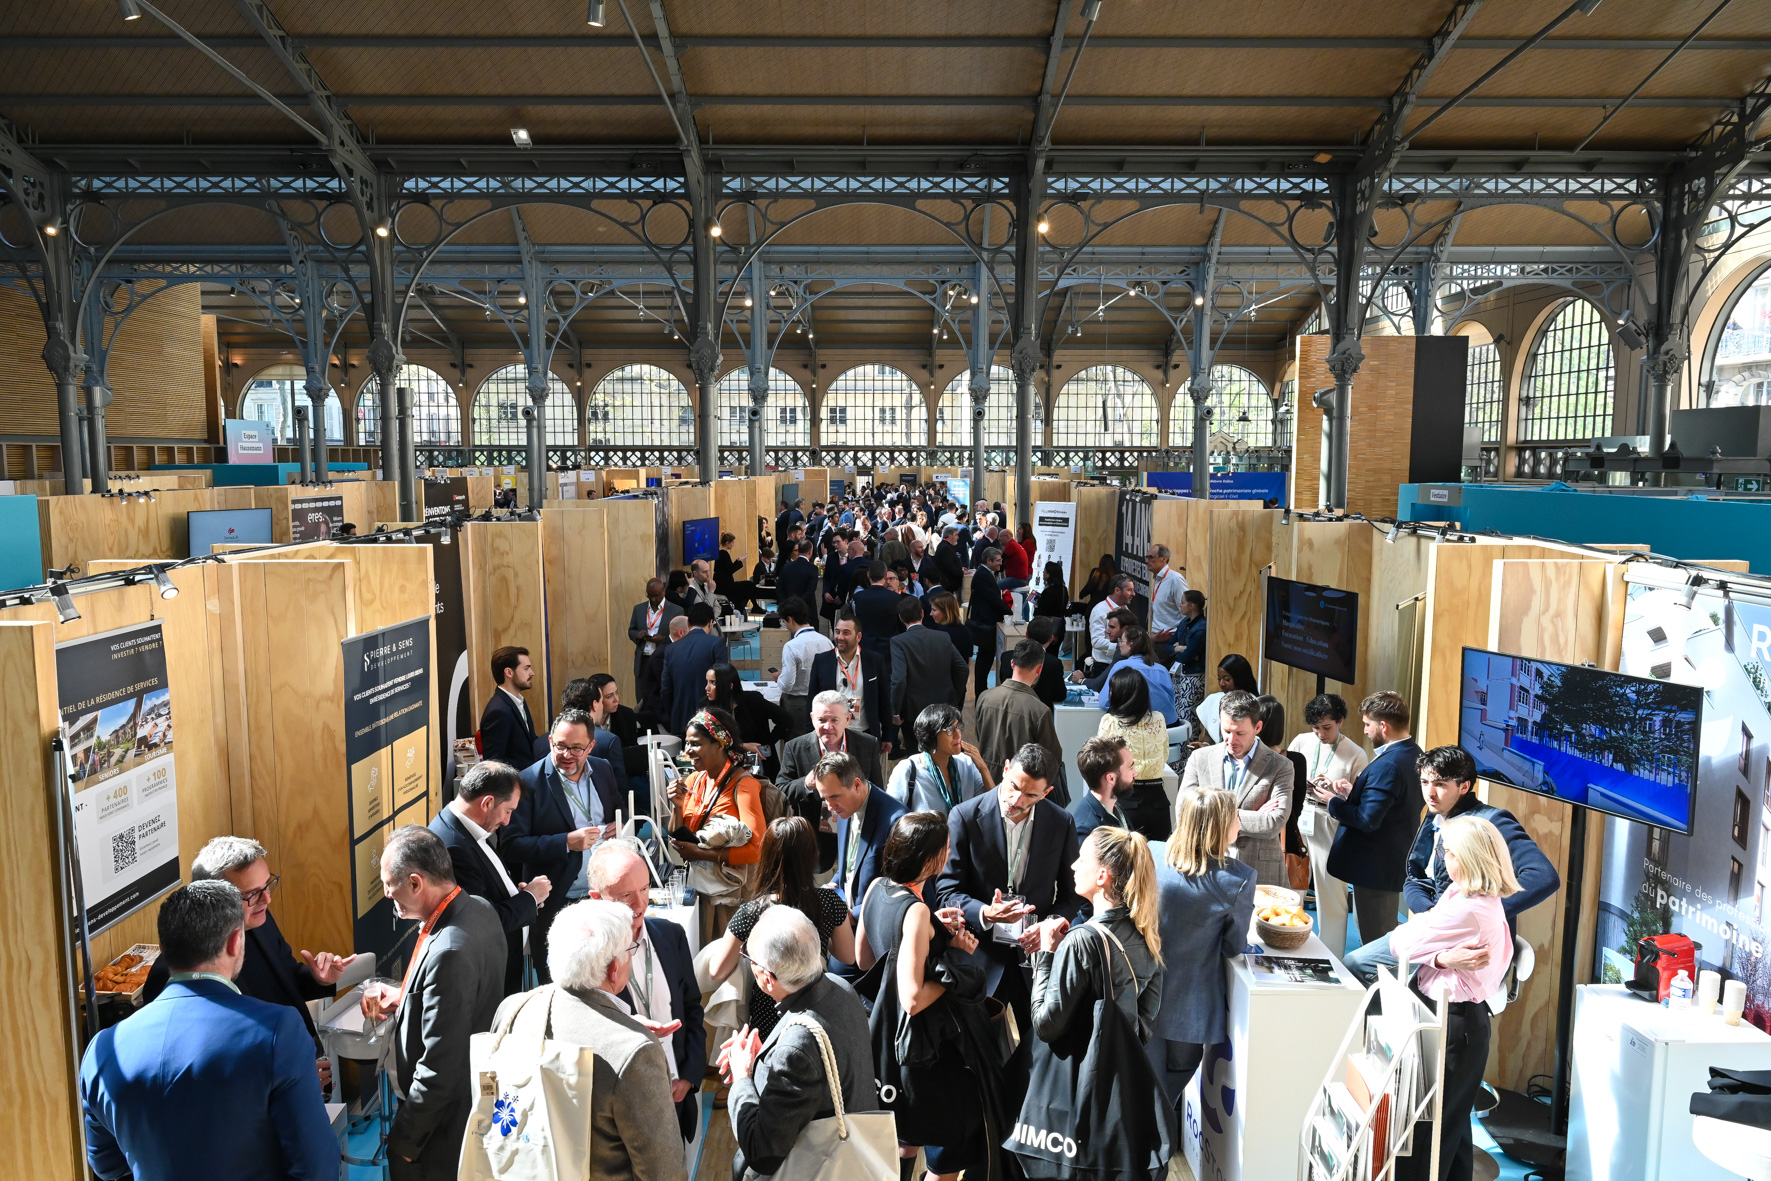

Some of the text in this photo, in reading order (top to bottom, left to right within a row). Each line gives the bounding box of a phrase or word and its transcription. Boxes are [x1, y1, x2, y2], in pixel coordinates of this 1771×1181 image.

[243, 432, 257, 440] Espace
[308, 512, 324, 523] eres.
[1122, 500, 1132, 553] 14
[120, 641, 136, 649] CLIENTS
[137, 633, 161, 644] SOUHAITENT
[370, 638, 413, 659] PIERRE & SENS
[112, 650, 134, 660] INVESTIR
[139, 643, 158, 652] VENDRE
[371, 650, 413, 670] DEVELOPPEMENT
[78, 701, 86, 710] DE
[87, 699, 95, 707] LA
[96, 688, 126, 704] RÉSIDENCE
[127, 685, 134, 694] DE
[135, 677, 158, 692] SERVICES
[144, 747, 167, 760] TOURISME
[99, 768, 119, 782] SENIORS
[153, 768, 166, 781] 100
[113, 785, 128, 799] 400
[142, 778, 168, 793] PROGRAMMES
[75, 803, 83, 812] NT
[101, 797, 129, 813] PARTENAIRES
[138, 815, 160, 832] DEVENEZ
[138, 821, 166, 840] PARTENAIRE
[1643, 858, 1692, 892] Partenaire
[1695, 886, 1712, 904] des
[1642, 882, 1763, 958] du patrimoine
[1187, 1100, 1226, 1181] ROCSTO
